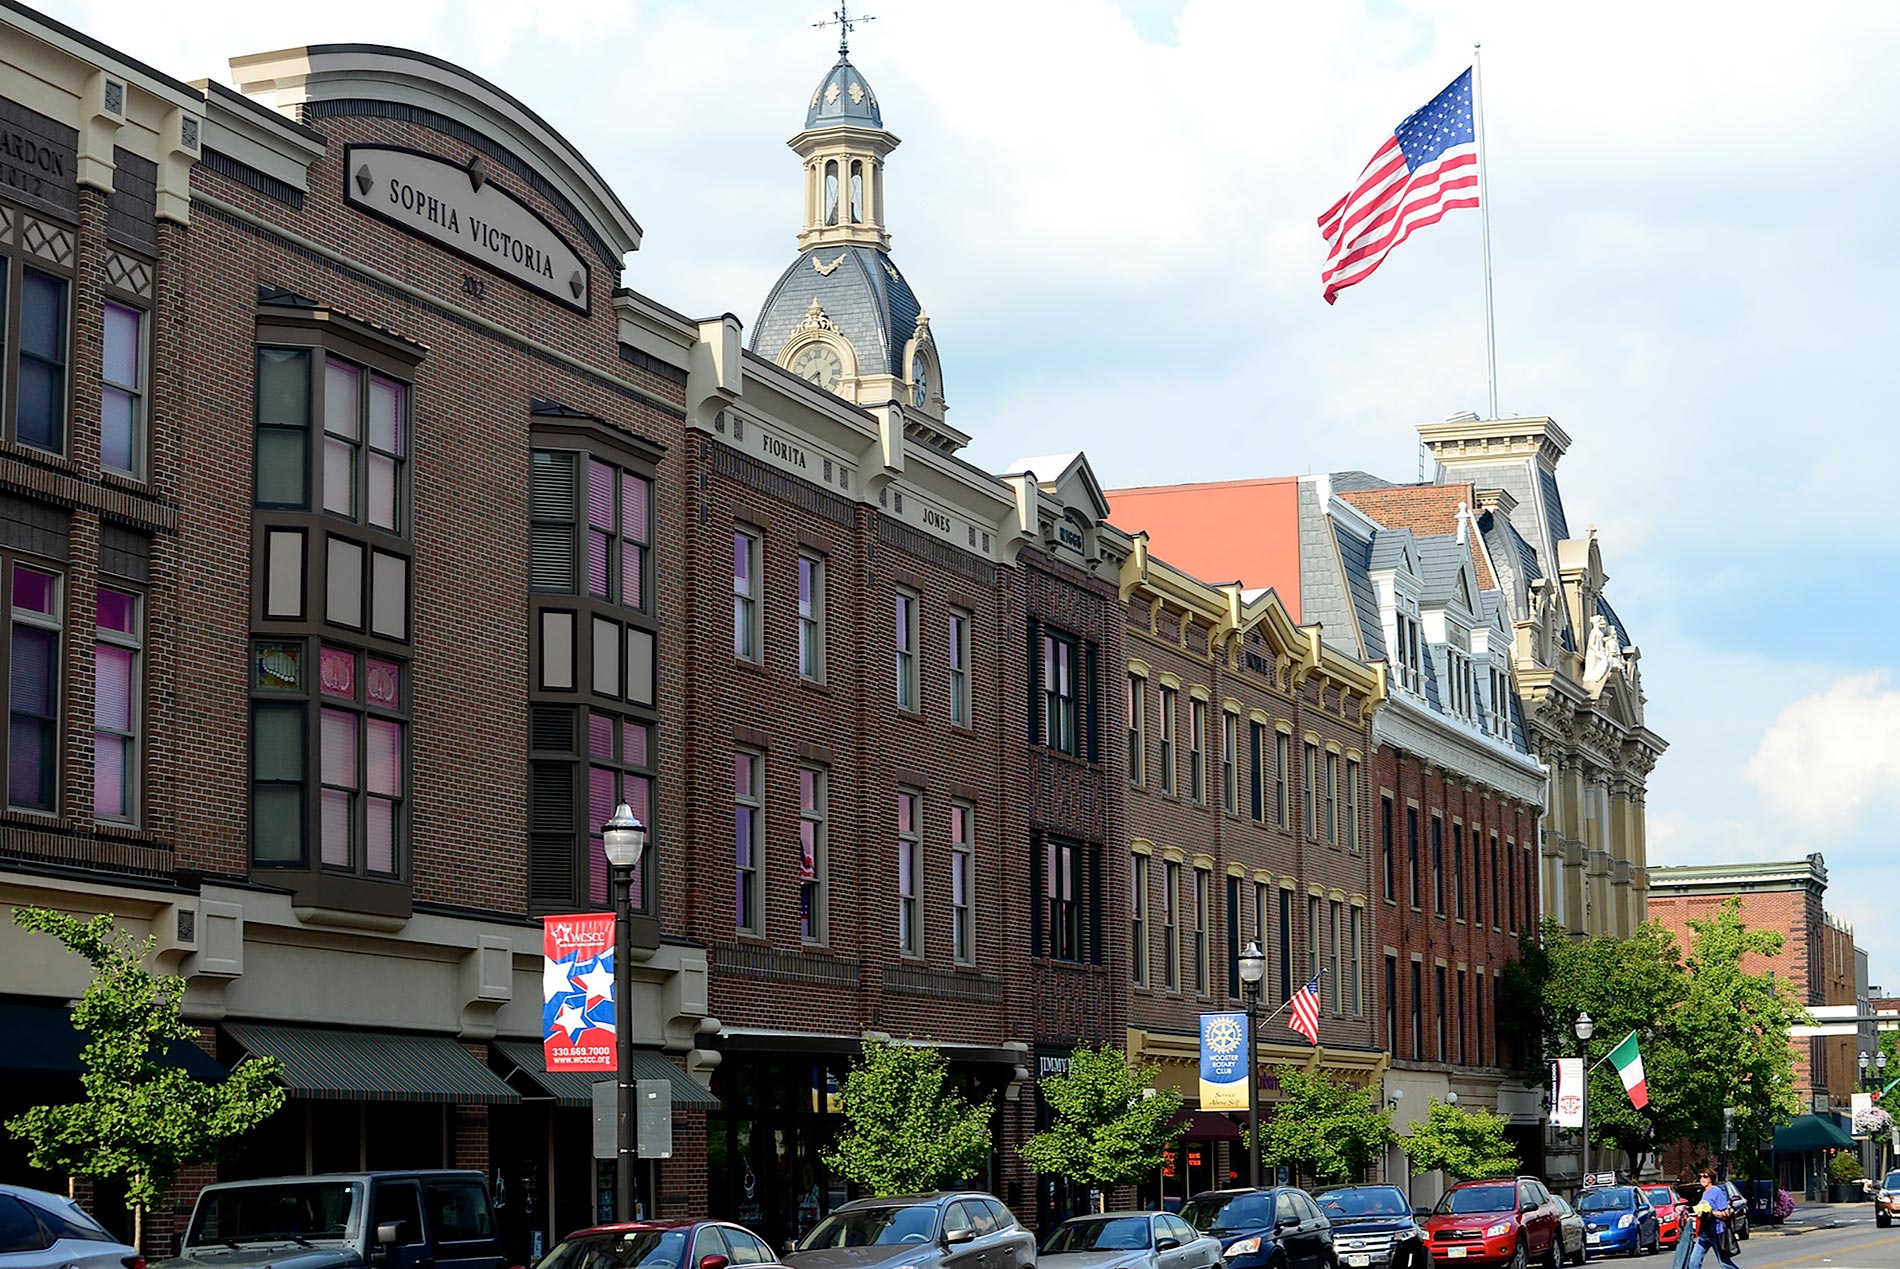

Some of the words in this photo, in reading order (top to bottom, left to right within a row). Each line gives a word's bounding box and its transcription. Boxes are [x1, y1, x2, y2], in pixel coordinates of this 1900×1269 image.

[389, 178, 460, 234] SOPHIA
[469, 216, 554, 279] VICTORIA
[762, 434, 806, 468] FIORITA
[922, 508, 951, 533] JONES
[552, 1046, 611, 1056] 330.669.7000
[552, 1056, 611, 1065] www.wcscc.org
